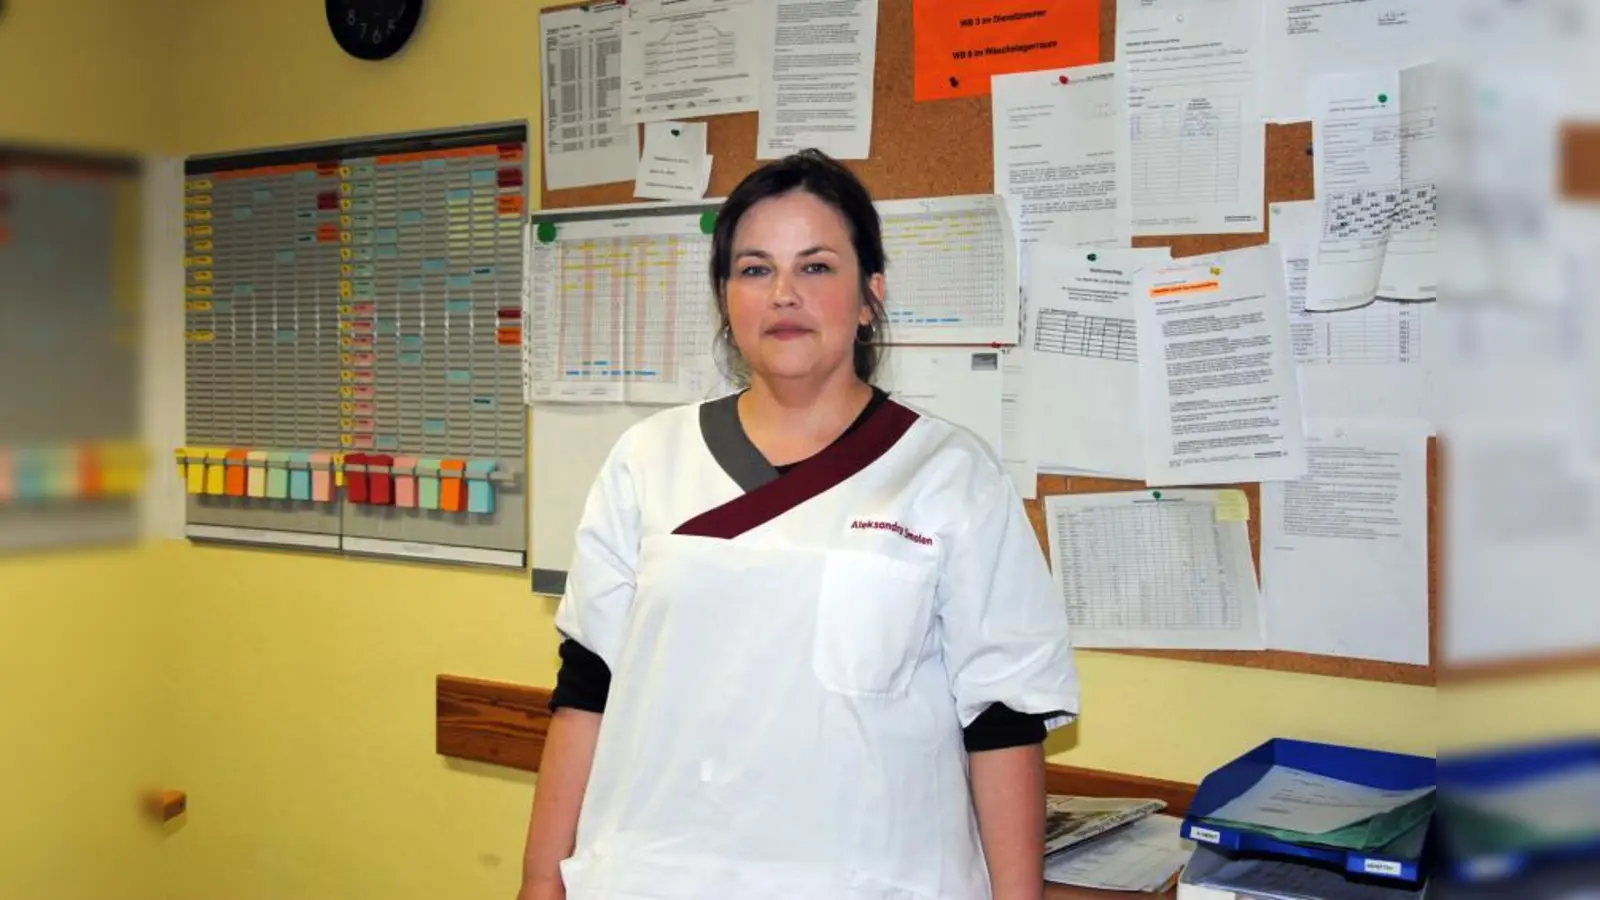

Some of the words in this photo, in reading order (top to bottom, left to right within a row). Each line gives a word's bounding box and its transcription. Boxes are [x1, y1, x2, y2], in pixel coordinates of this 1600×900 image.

[347, 8, 356, 26] 8
[359, 22, 369, 40] 7
[373, 26, 382, 45] 6
